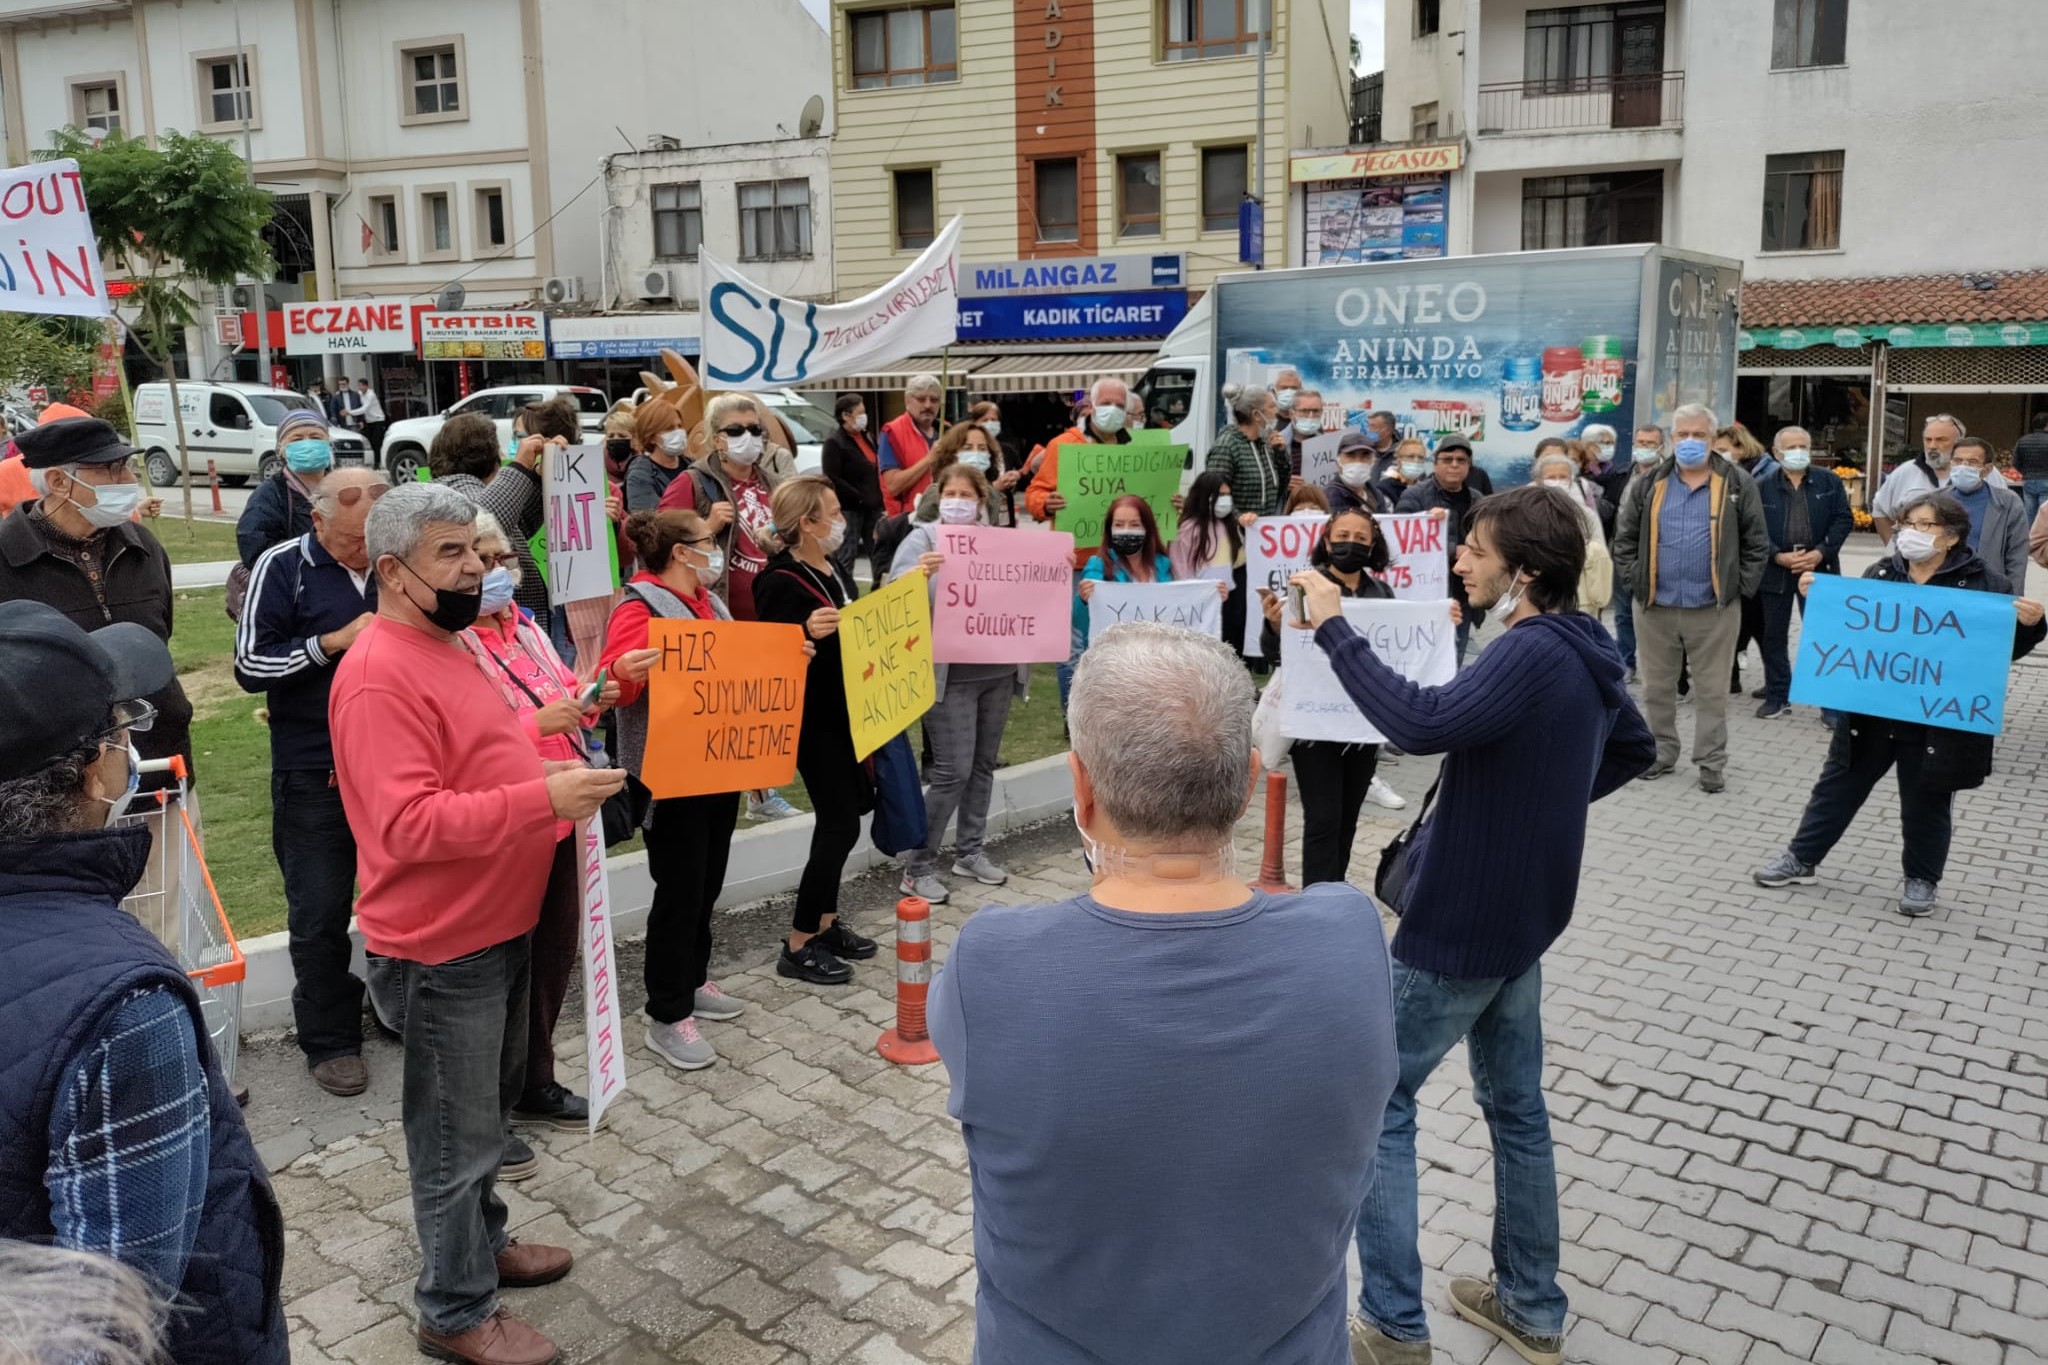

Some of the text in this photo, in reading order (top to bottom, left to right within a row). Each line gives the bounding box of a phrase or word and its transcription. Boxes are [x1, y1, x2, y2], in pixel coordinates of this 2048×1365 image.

[1351, 150, 1451, 173] PEGASUS
[2, 172, 86, 219] OUT
[1023, 303, 1164, 326] KADIK TİCARET
[1334, 281, 1487, 327] ONEO
[289, 304, 404, 335] ECZANE
[425, 314, 537, 330] TATBİR
[706, 281, 819, 383] SU
[328, 336, 368, 349] HAYAL
[1332, 335, 1483, 362] ANINDA
[1331, 363, 1483, 380] FERAHLATIYO
[1582, 373, 1617, 391] ONEO
[1503, 394, 1539, 415] ONEO
[1542, 384, 1578, 404] ONEO
[1078, 476, 1126, 497] SUYA
[945, 533, 979, 556] TEK
[1393, 517, 1443, 554] VAR
[946, 581, 978, 608] SU
[852, 588, 920, 651] DENİZE
[1106, 601, 1206, 627] YAKAN
[662, 630, 717, 672] HZR
[879, 640, 900, 677] NE
[1812, 641, 1943, 686] YANGIN
[692, 676, 798, 717] SUYUMUZU
[1919, 694, 1995, 725] VAR
[704, 722, 795, 763] KİRLETME
